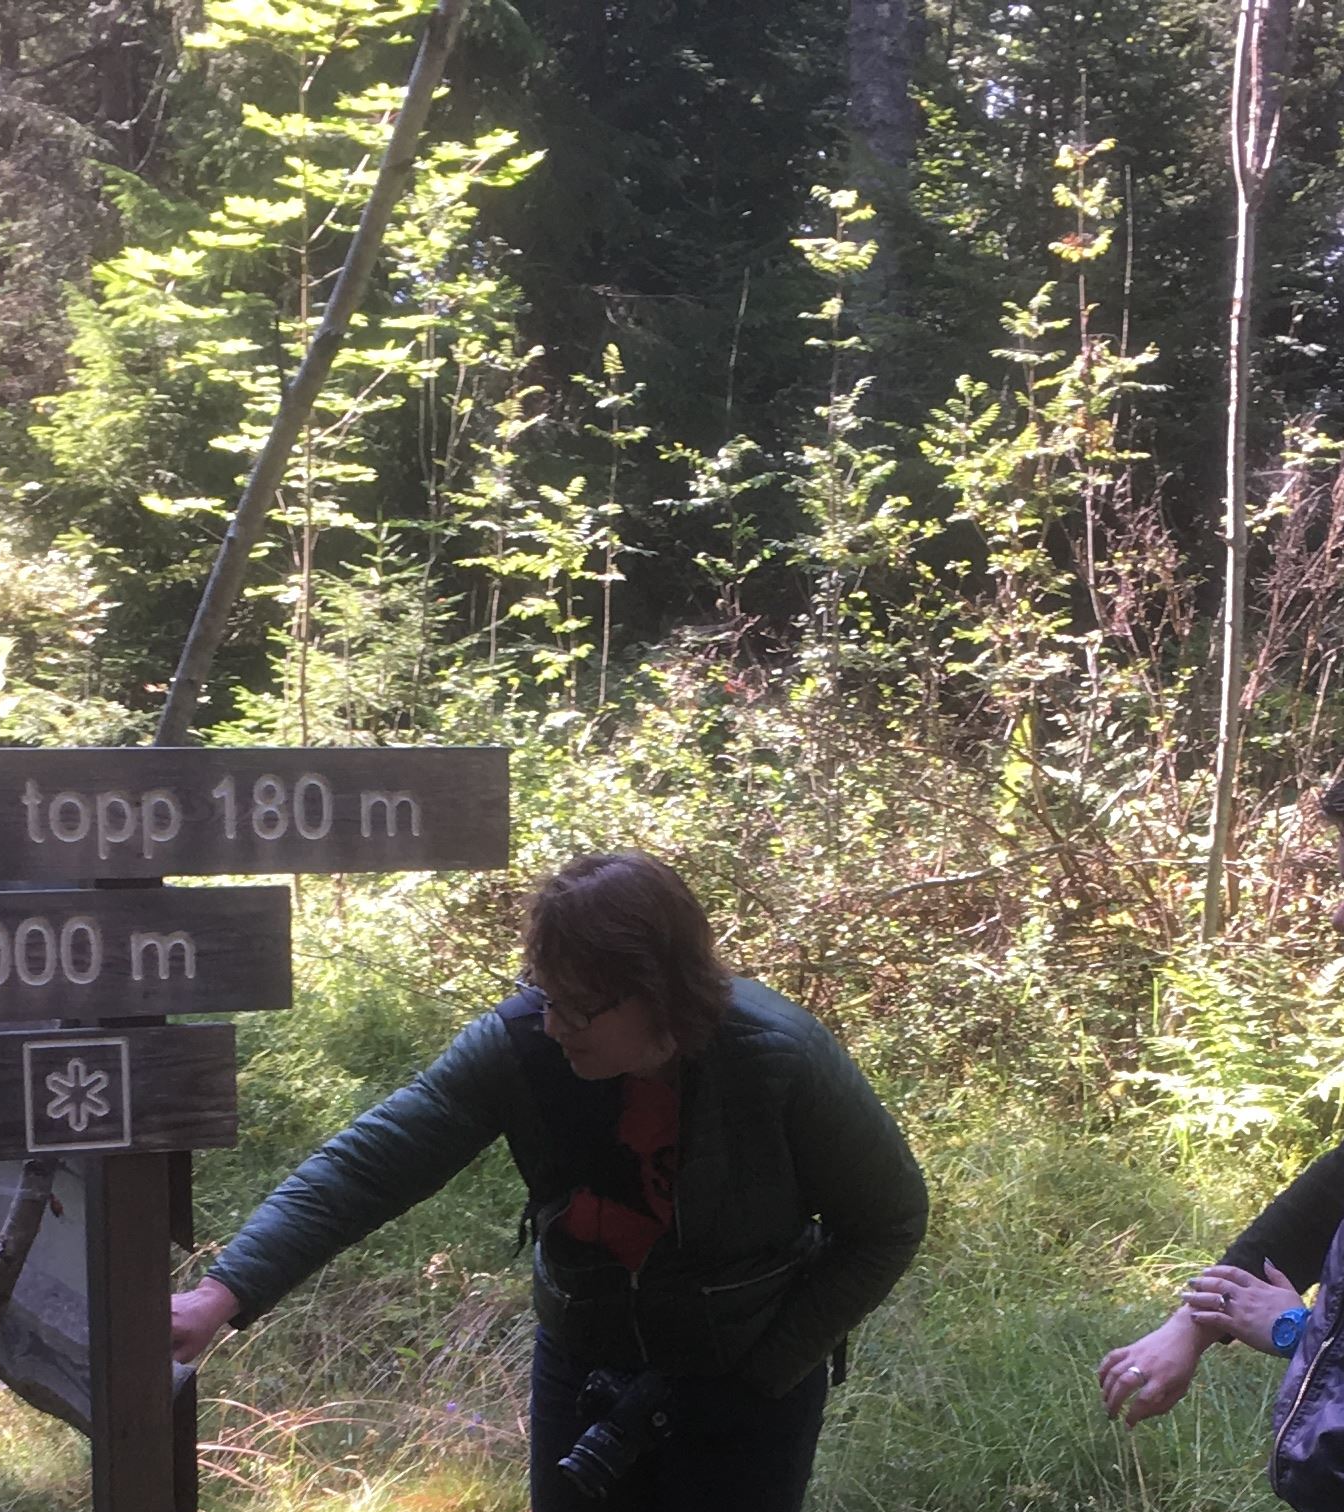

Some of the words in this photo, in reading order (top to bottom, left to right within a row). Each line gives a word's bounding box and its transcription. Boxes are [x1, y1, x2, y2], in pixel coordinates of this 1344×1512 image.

[21, 778, 182, 859] topp
[212, 773, 333, 840] 180
[360, 789, 422, 837] m
[130, 931, 197, 981] m
